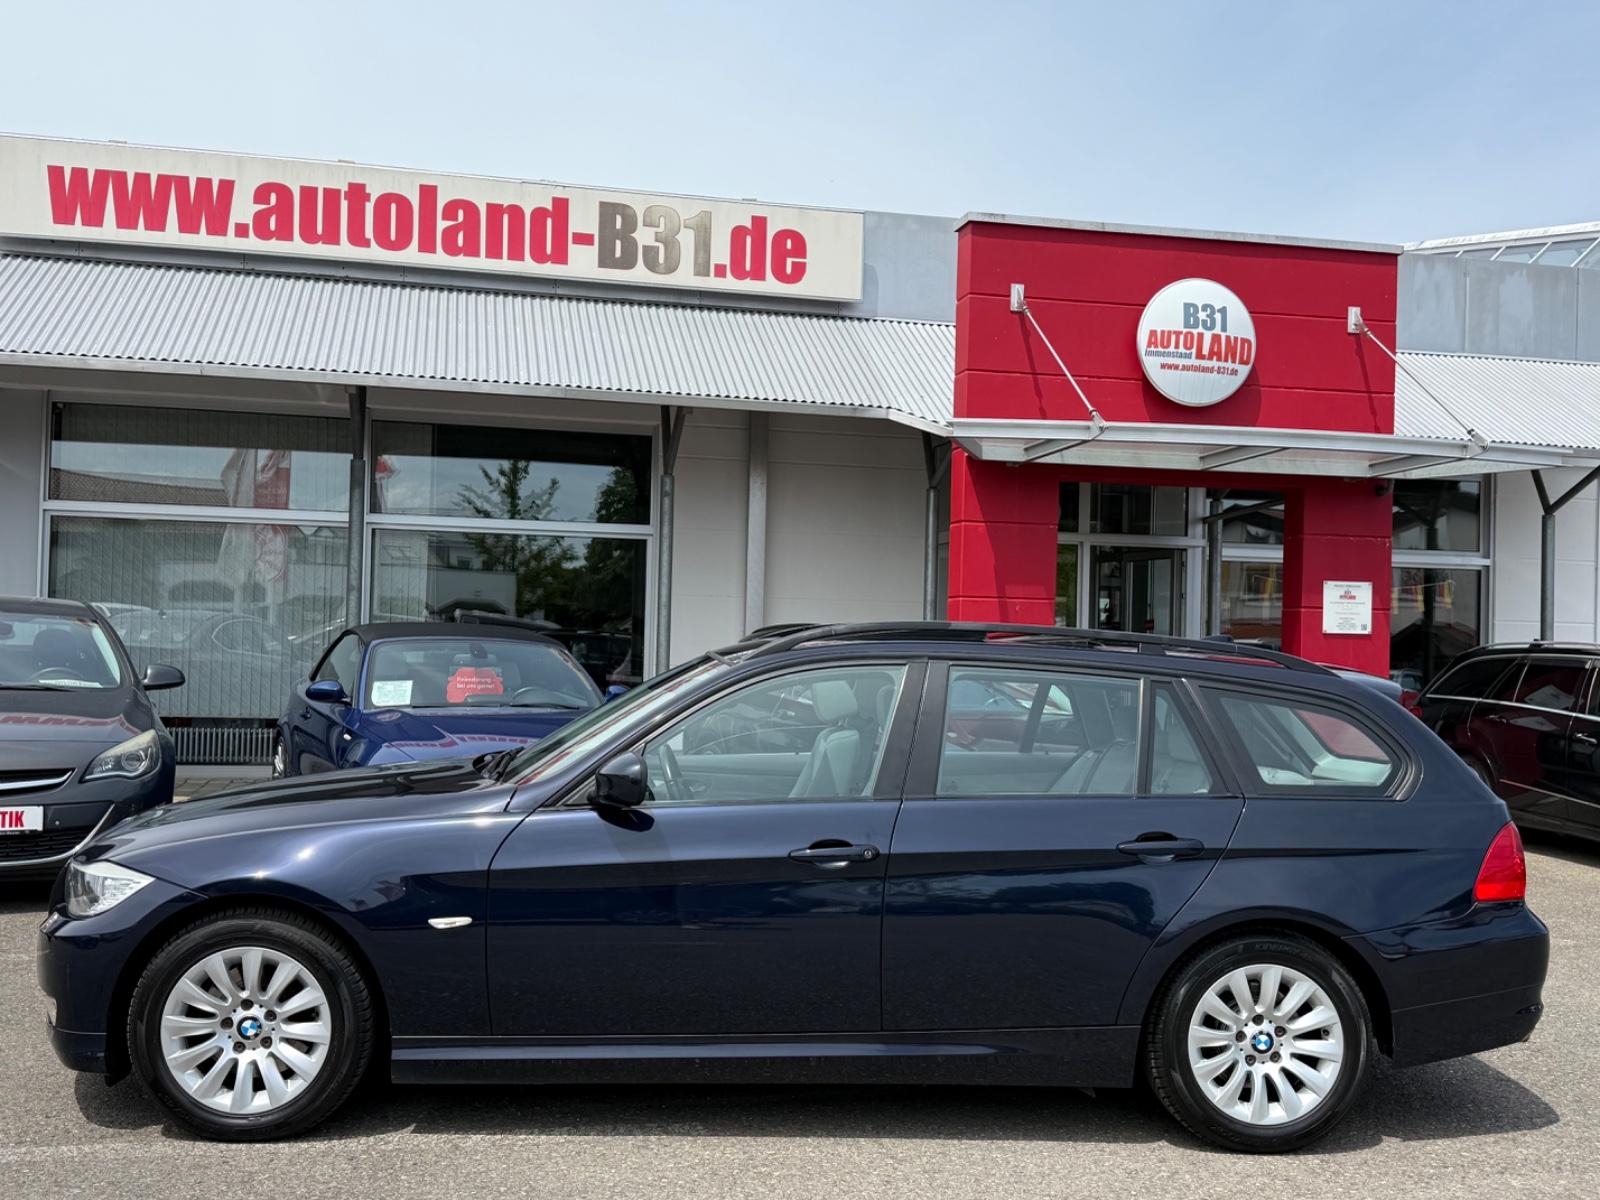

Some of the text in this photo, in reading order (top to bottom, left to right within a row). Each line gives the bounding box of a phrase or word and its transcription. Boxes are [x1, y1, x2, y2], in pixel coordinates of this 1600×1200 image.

[47, 165, 807, 285] www.autoland-B31.de
[1183, 302, 1228, 333] B31
[1145, 348, 1193, 360] Immenstaad
[1160, 361, 1239, 377] www.autoland-B31.de
